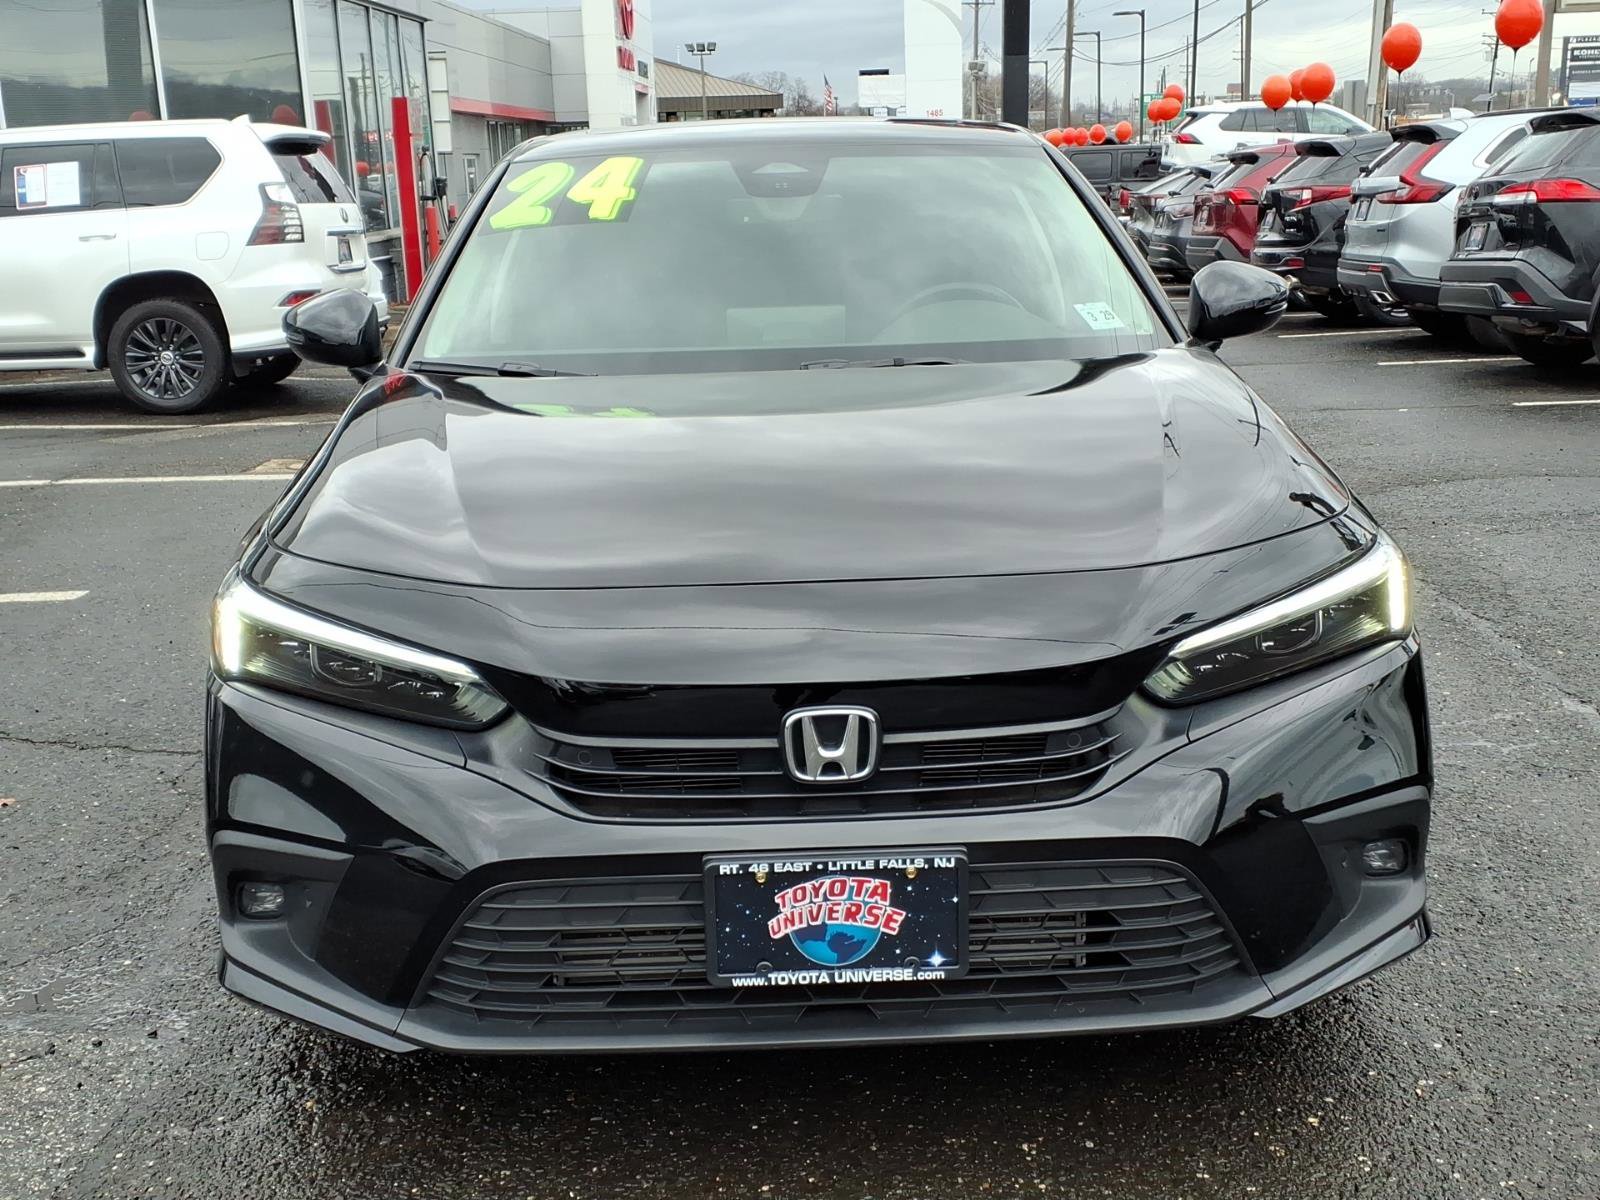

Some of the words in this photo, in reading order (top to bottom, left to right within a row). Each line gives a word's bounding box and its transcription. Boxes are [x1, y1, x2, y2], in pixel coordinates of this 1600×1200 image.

[489, 157, 644, 229] 24
[719, 864, 743, 875] RT.
[748, 862, 769, 873] 46
[773, 861, 813, 873] EAST
[828, 860, 875, 871] LITTLE
[879, 858, 929, 870] FALLS,
[934, 857, 956, 868] NJ
[775, 877, 891, 911] TOYOTA
[767, 901, 906, 938] UNIVERSE
[731, 971, 830, 987] www.TOYOTA
[834, 967, 945, 983] UNIVERSE.com
